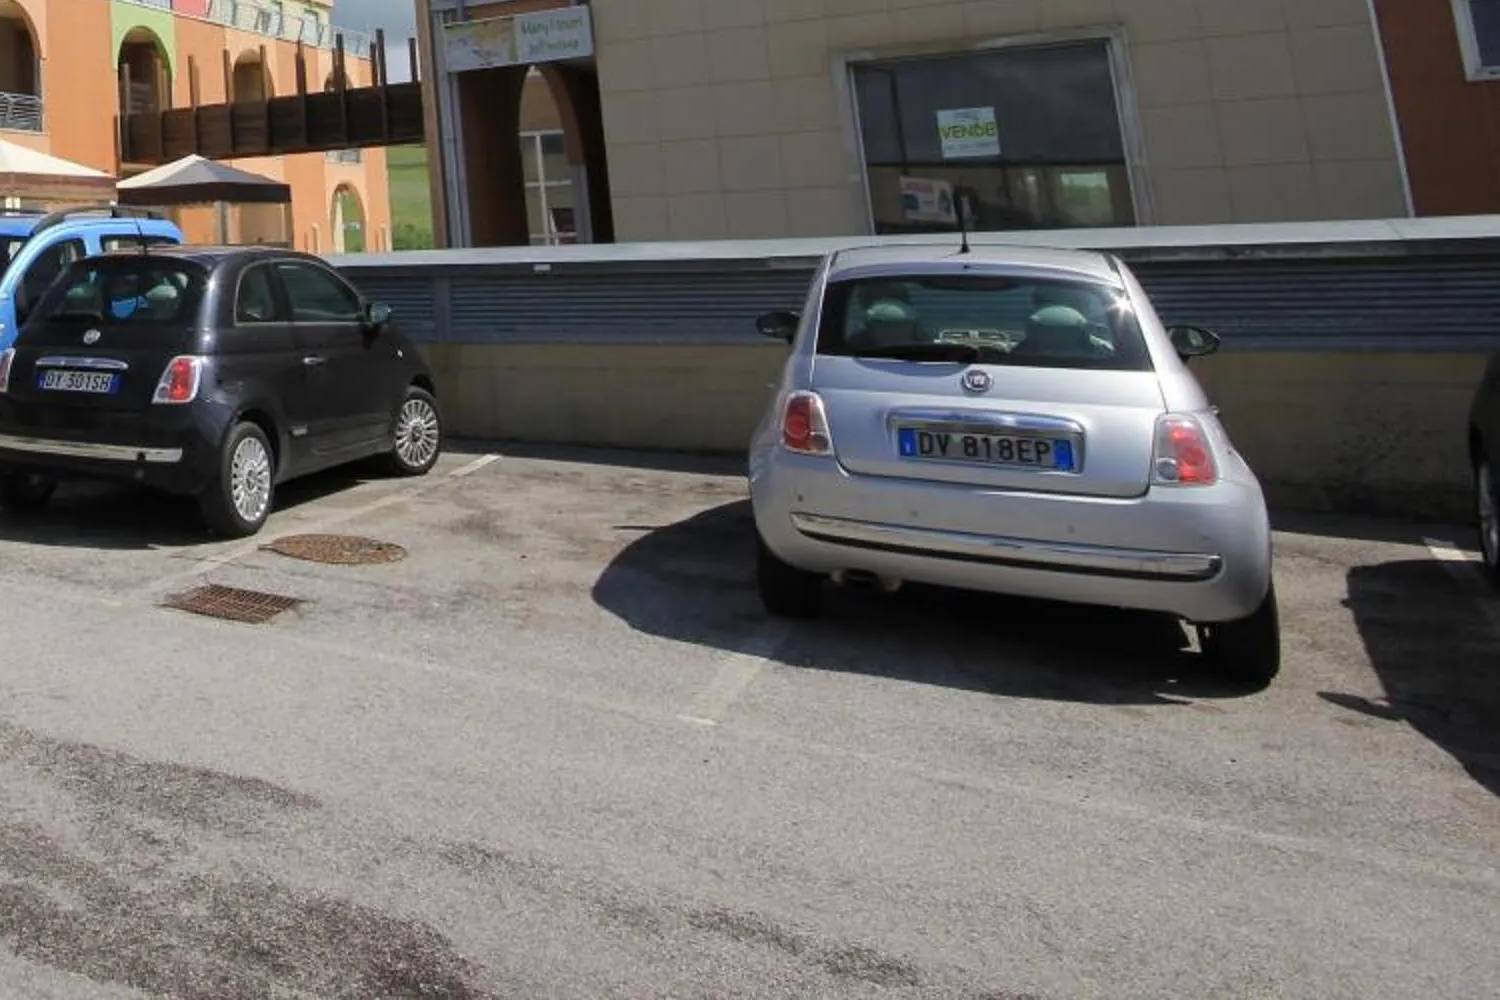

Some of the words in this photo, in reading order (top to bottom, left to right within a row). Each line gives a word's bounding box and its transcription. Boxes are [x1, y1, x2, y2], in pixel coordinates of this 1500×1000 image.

[940, 122, 997, 139] VENDE
[918, 432, 950, 456] DV
[963, 436, 1050, 463] 818EP
